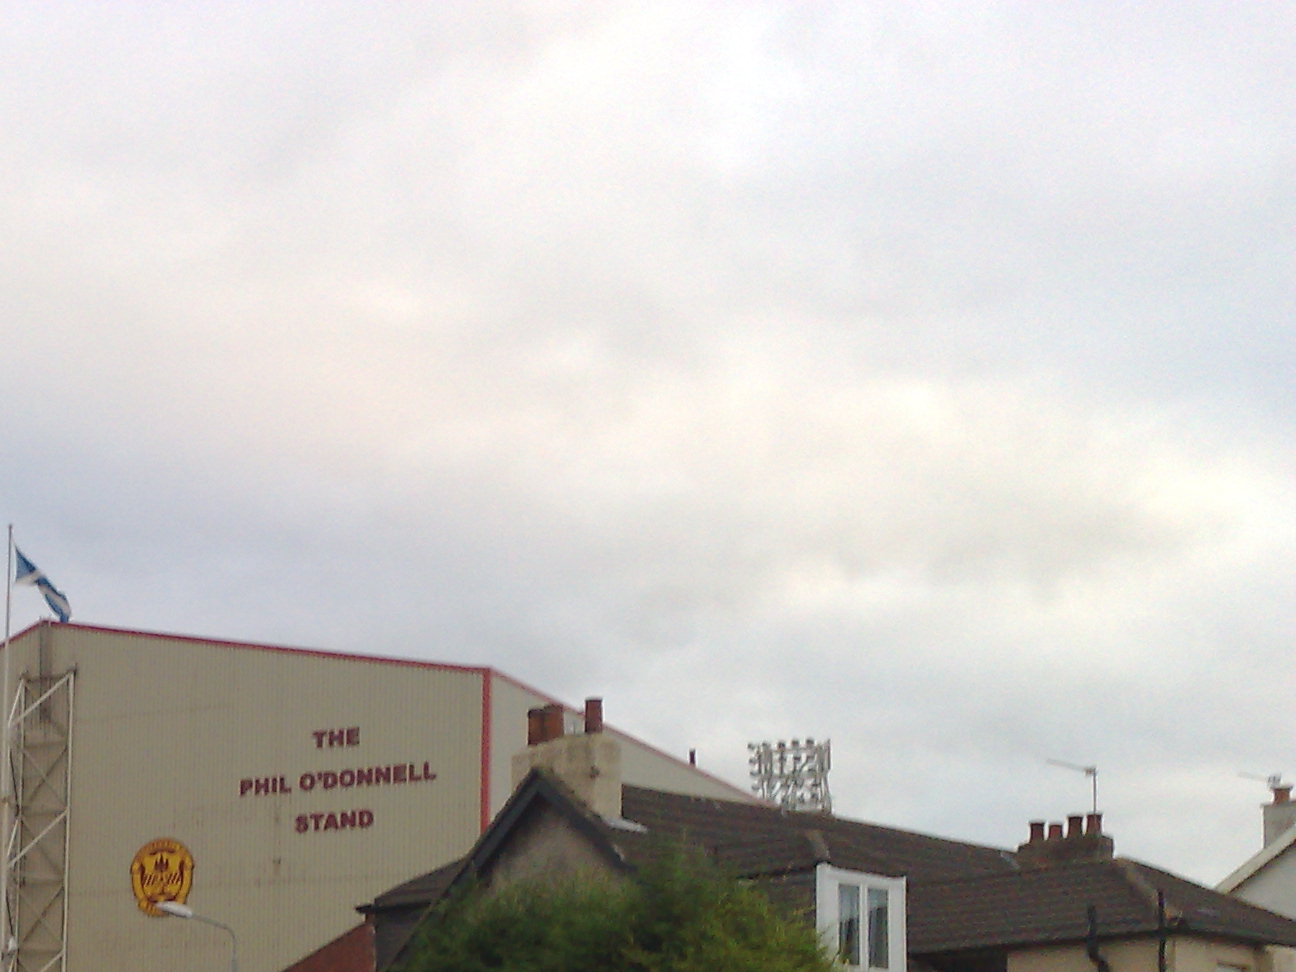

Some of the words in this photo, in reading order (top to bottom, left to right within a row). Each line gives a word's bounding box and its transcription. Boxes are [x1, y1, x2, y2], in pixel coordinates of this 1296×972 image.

[313, 727, 360, 749] THE
[240, 774, 292, 797] PHIL
[298, 761, 437, 792] O'DONNELL
[295, 809, 375, 834] STAND
